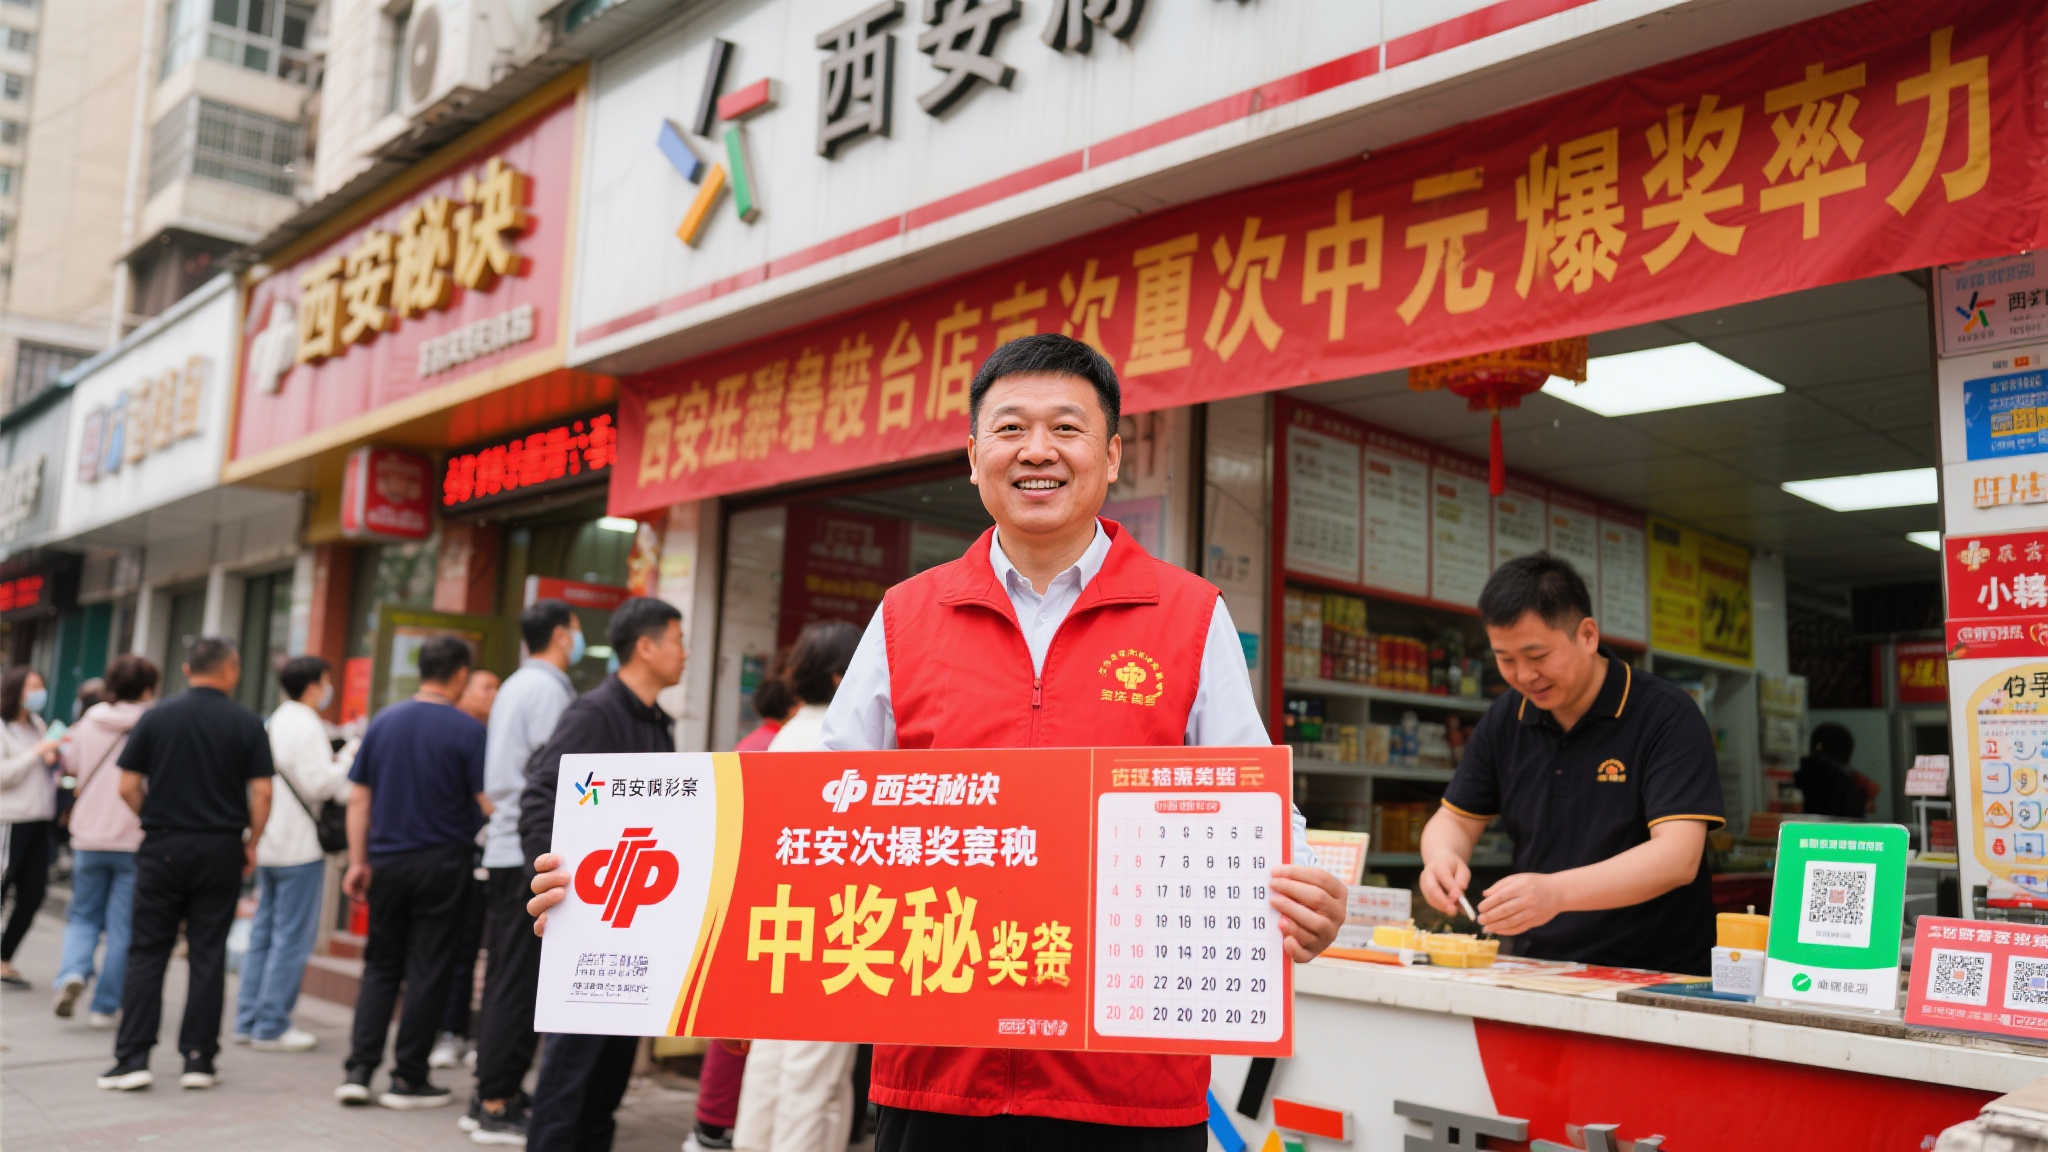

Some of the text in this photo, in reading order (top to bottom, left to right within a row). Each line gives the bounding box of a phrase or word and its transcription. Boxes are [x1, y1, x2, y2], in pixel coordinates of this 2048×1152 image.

[297, 156, 522, 365] 西安秘诀
[871, 771, 1001, 806] 西安秘诀
[1158, 854, 1166, 869] 7
[1158, 885, 1167, 897] 17
[1202, 946, 1216, 960] 20
[1226, 947, 1241, 960] 20
[1251, 947, 1265, 960] 20
[1128, 974, 1145, 990] 20
[1154, 976, 1167, 989] 22
[1177, 976, 1192, 990] 20
[1201, 977, 1216, 991] 20
[1251, 978, 1265, 992] 20
[1106, 1004, 1121, 1021] 20
[1128, 1004, 1145, 1021] 20
[1153, 1007, 1167, 1021] 20
[1177, 1008, 1192, 1022] 20
[1201, 1008, 1216, 1022] 20
[1226, 1010, 1241, 1023] 20
